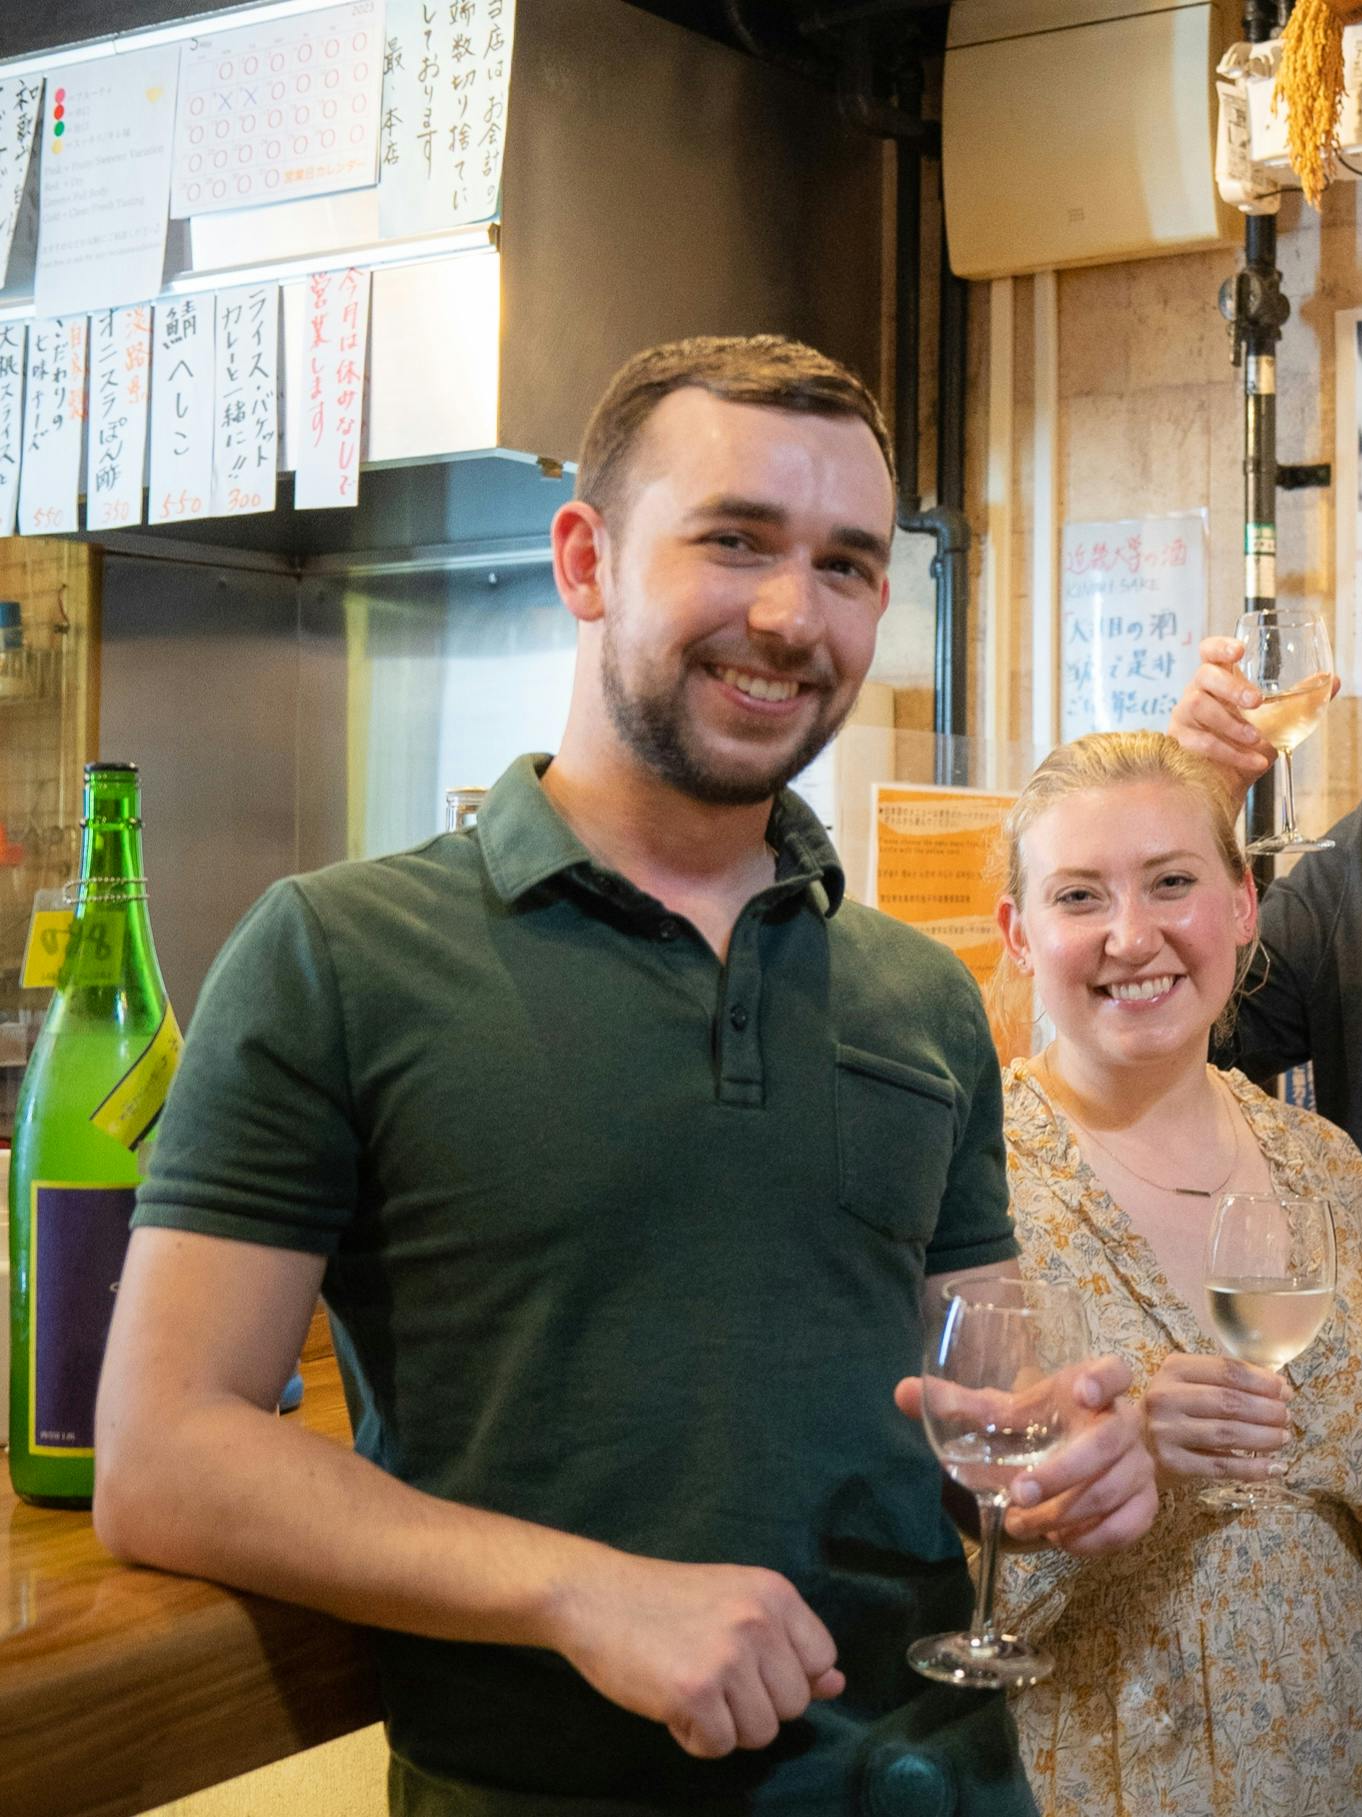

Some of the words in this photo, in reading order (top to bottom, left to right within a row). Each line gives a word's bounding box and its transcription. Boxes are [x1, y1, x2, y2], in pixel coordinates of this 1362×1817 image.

[416, 4, 440, 181] しております
[162, 300, 197, 456] 鯖へしこ
[160, 491, 202, 519] 550
[227, 487, 261, 511] 300
